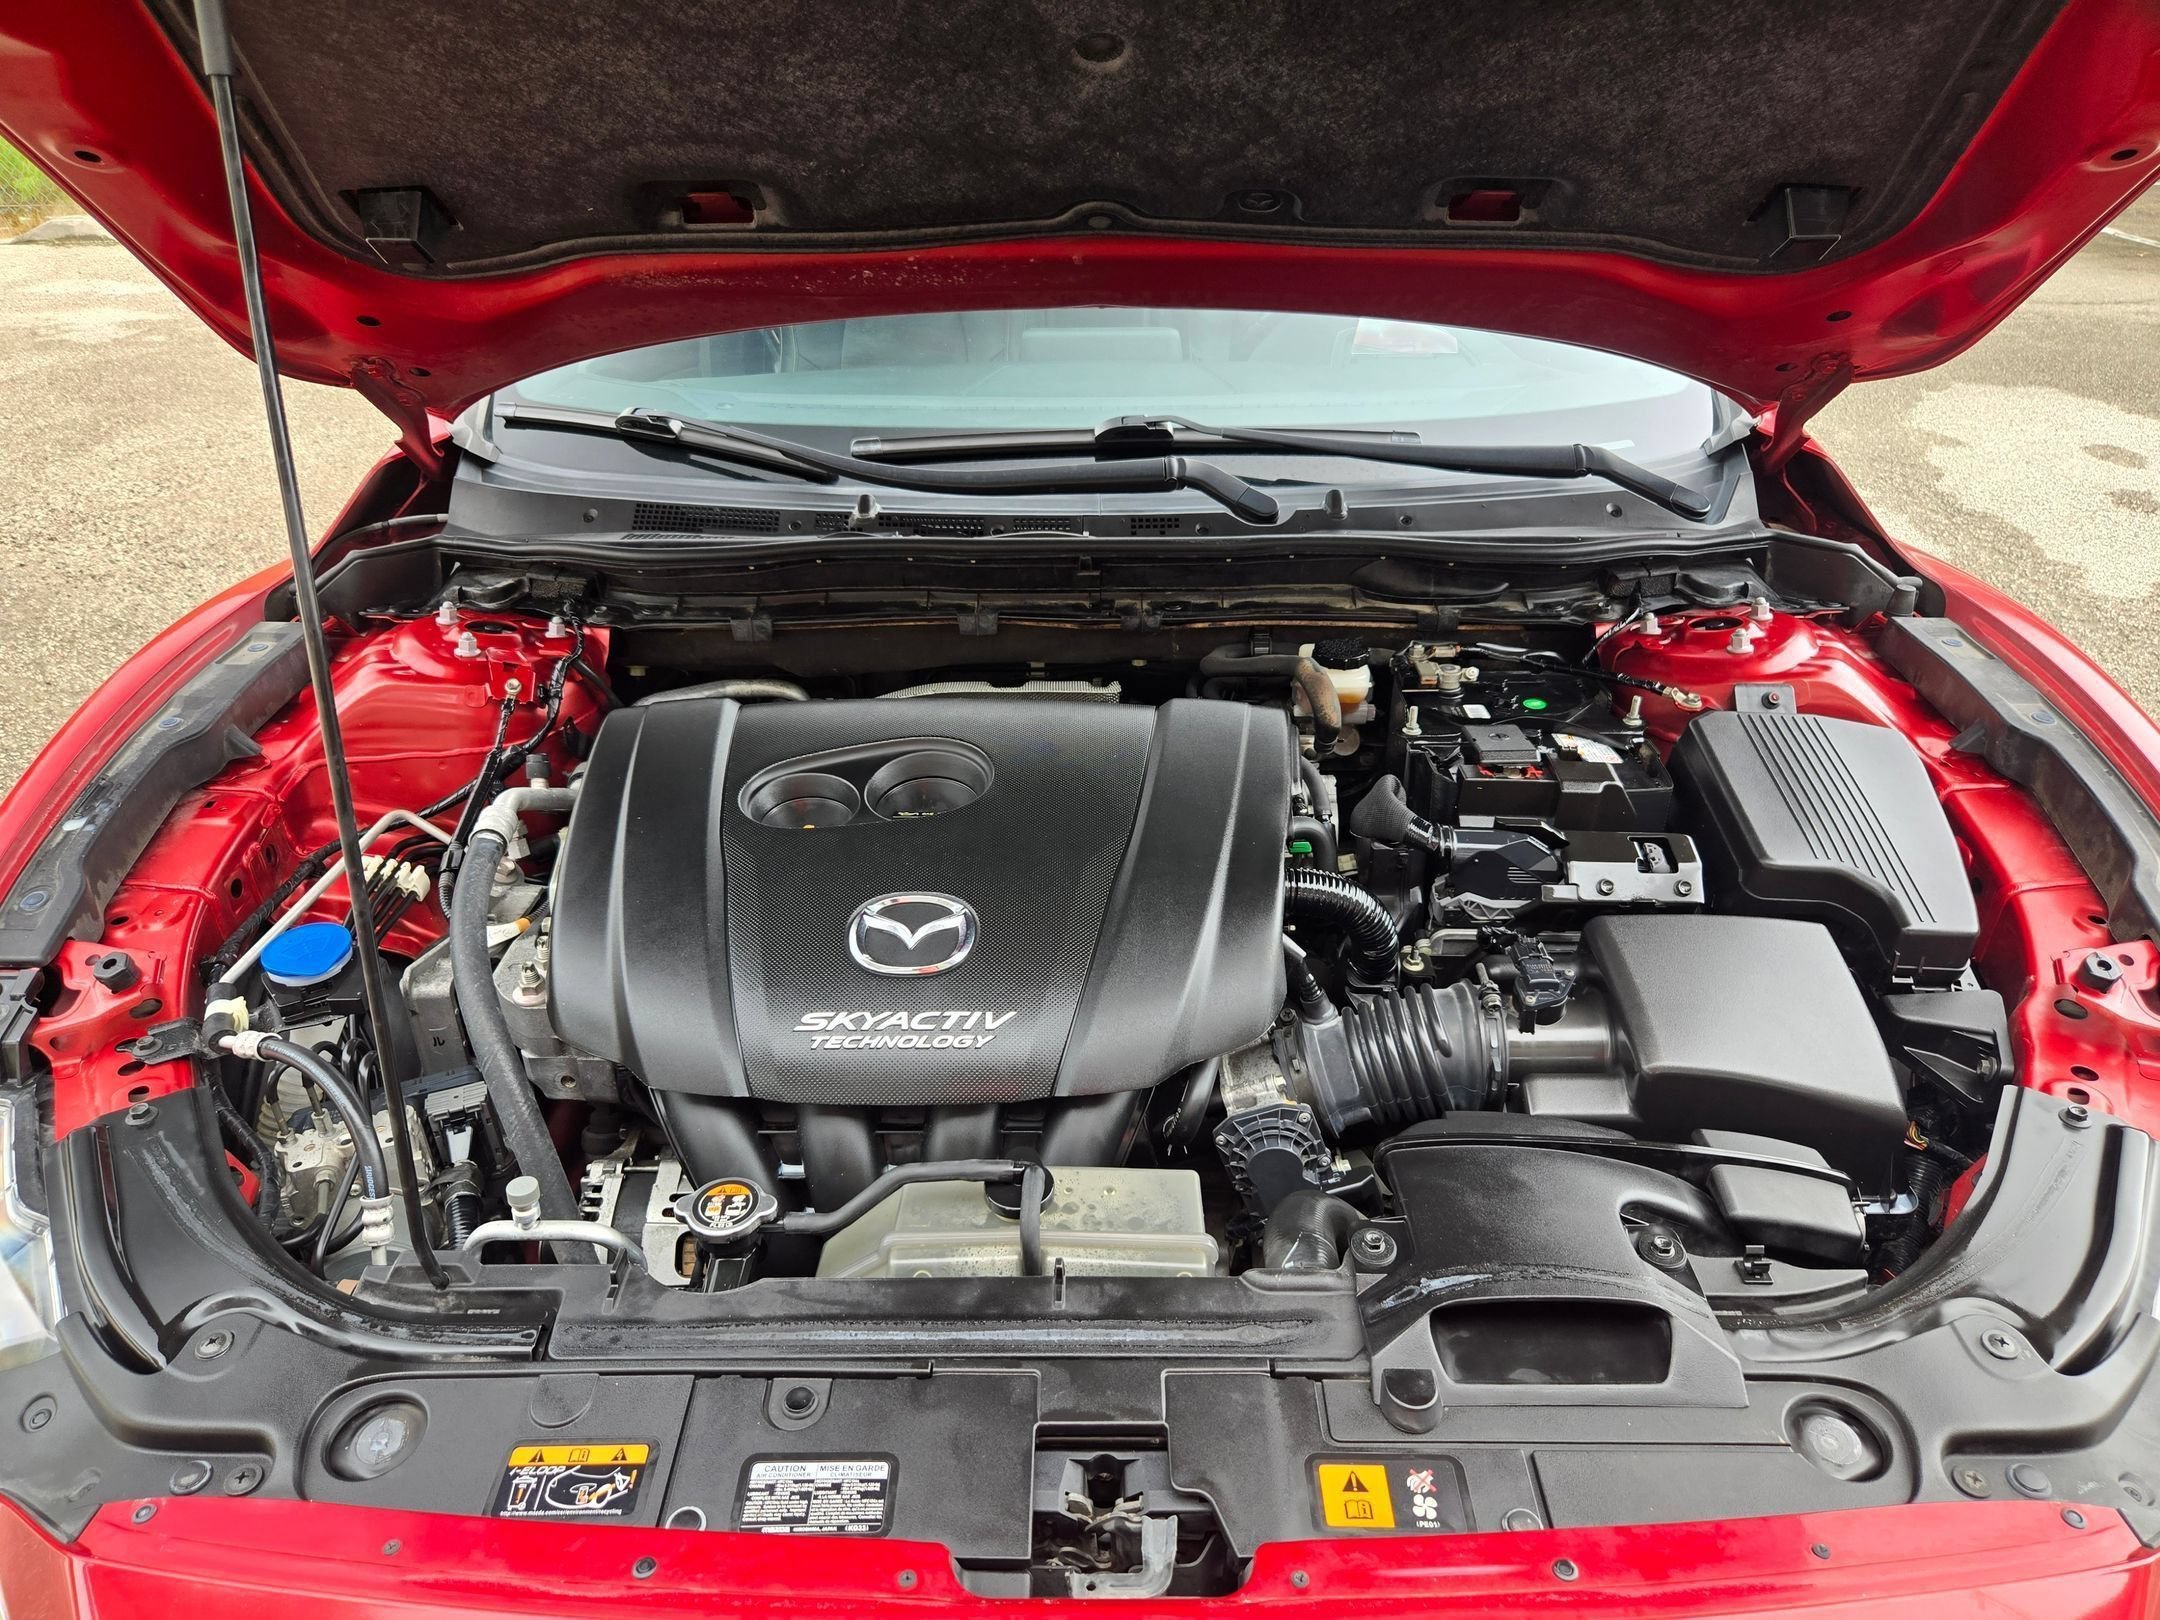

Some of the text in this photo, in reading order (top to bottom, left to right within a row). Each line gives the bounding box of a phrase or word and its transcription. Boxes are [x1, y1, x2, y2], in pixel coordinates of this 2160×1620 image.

[793, 1011, 1017, 1031] SKYACTIV
[810, 1035, 996, 1050] TECHNOLOGY
[819, 1464, 841, 1472] MISE
